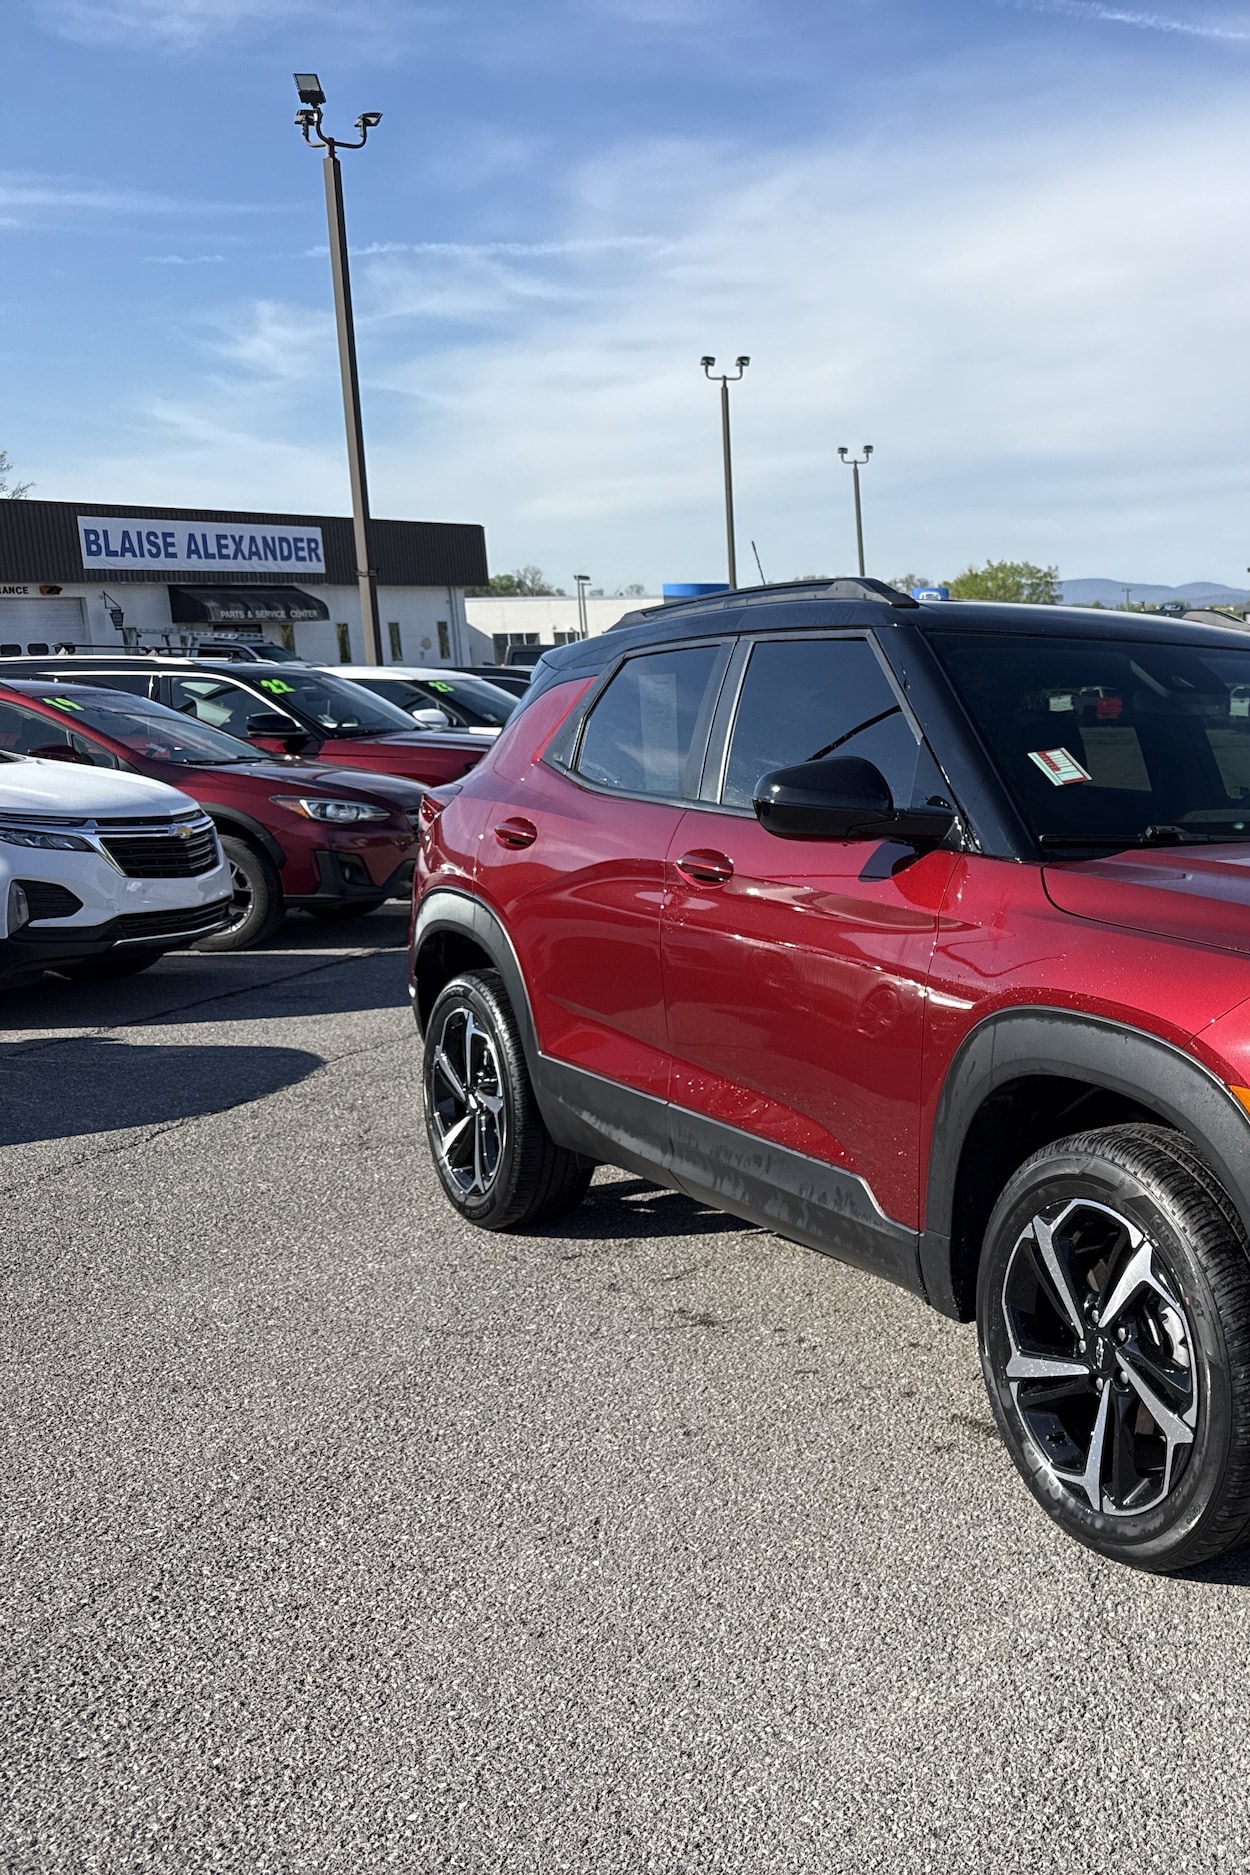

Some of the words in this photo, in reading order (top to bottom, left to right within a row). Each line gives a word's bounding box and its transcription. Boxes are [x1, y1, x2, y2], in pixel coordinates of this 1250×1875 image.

[83, 528, 178, 559] BLAISE
[186, 532, 322, 562] ALEXANDER
[0, 586, 29, 595] ANCE
[220, 610, 245, 618] PARTS
[247, 610, 253, 618] &
[255, 610, 286, 618] SERVICE
[289, 609, 318, 618] CENTER
[261, 679, 296, 694] 22
[42, 698, 85, 711] 19
